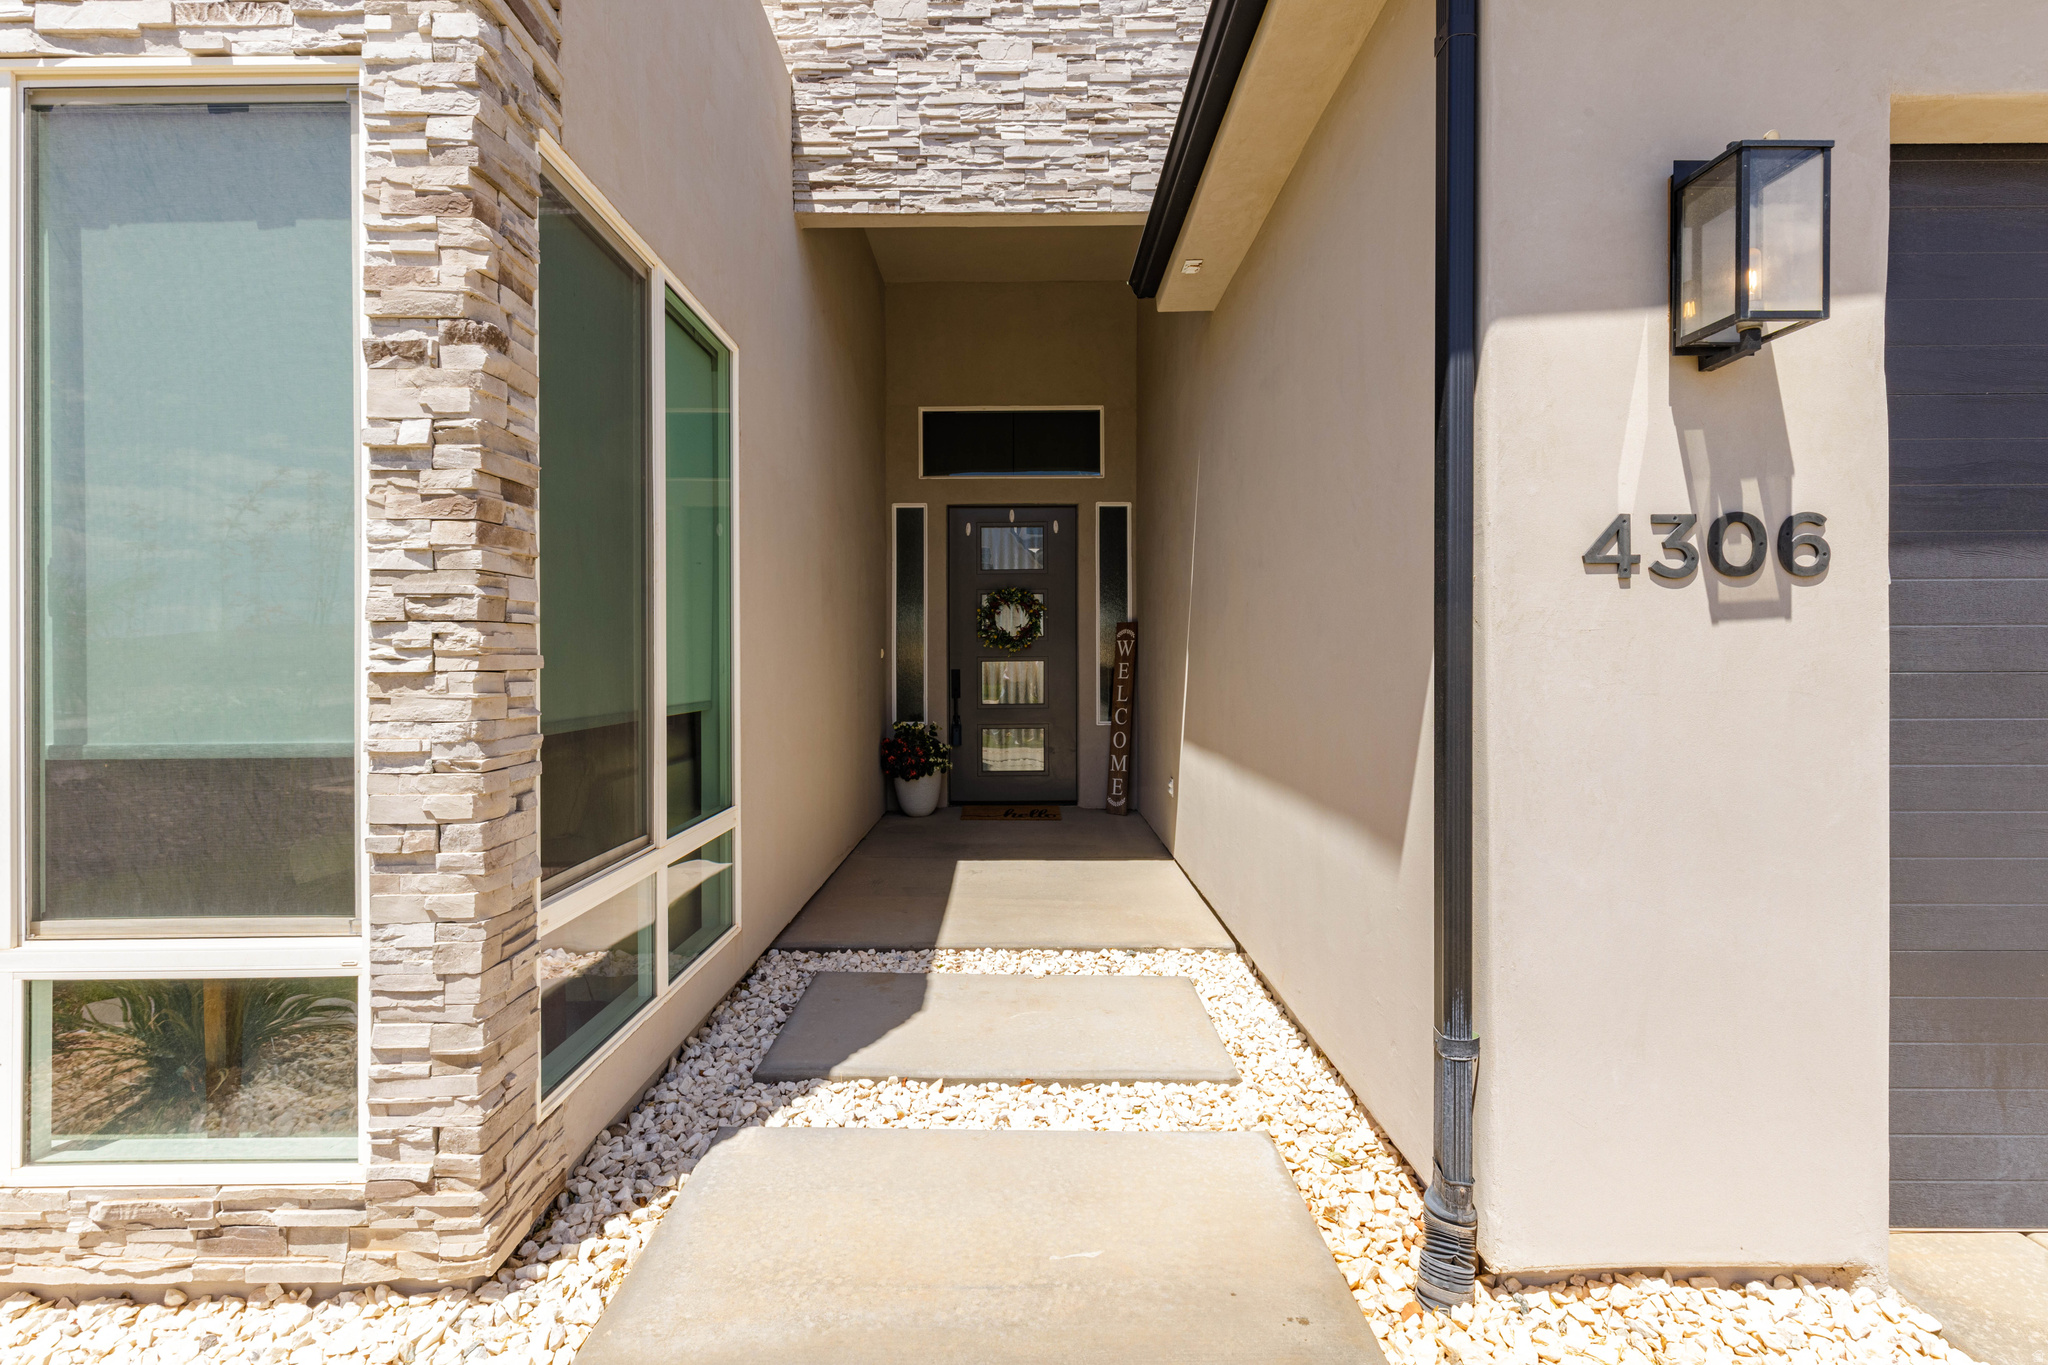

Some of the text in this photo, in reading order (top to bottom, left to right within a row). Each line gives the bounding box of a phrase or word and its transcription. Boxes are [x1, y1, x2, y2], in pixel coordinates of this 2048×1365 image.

[1582, 511, 1831, 579] 4306
[1110, 639, 1135, 796] WELCOME
[1003, 808, 1057, 818] hello
